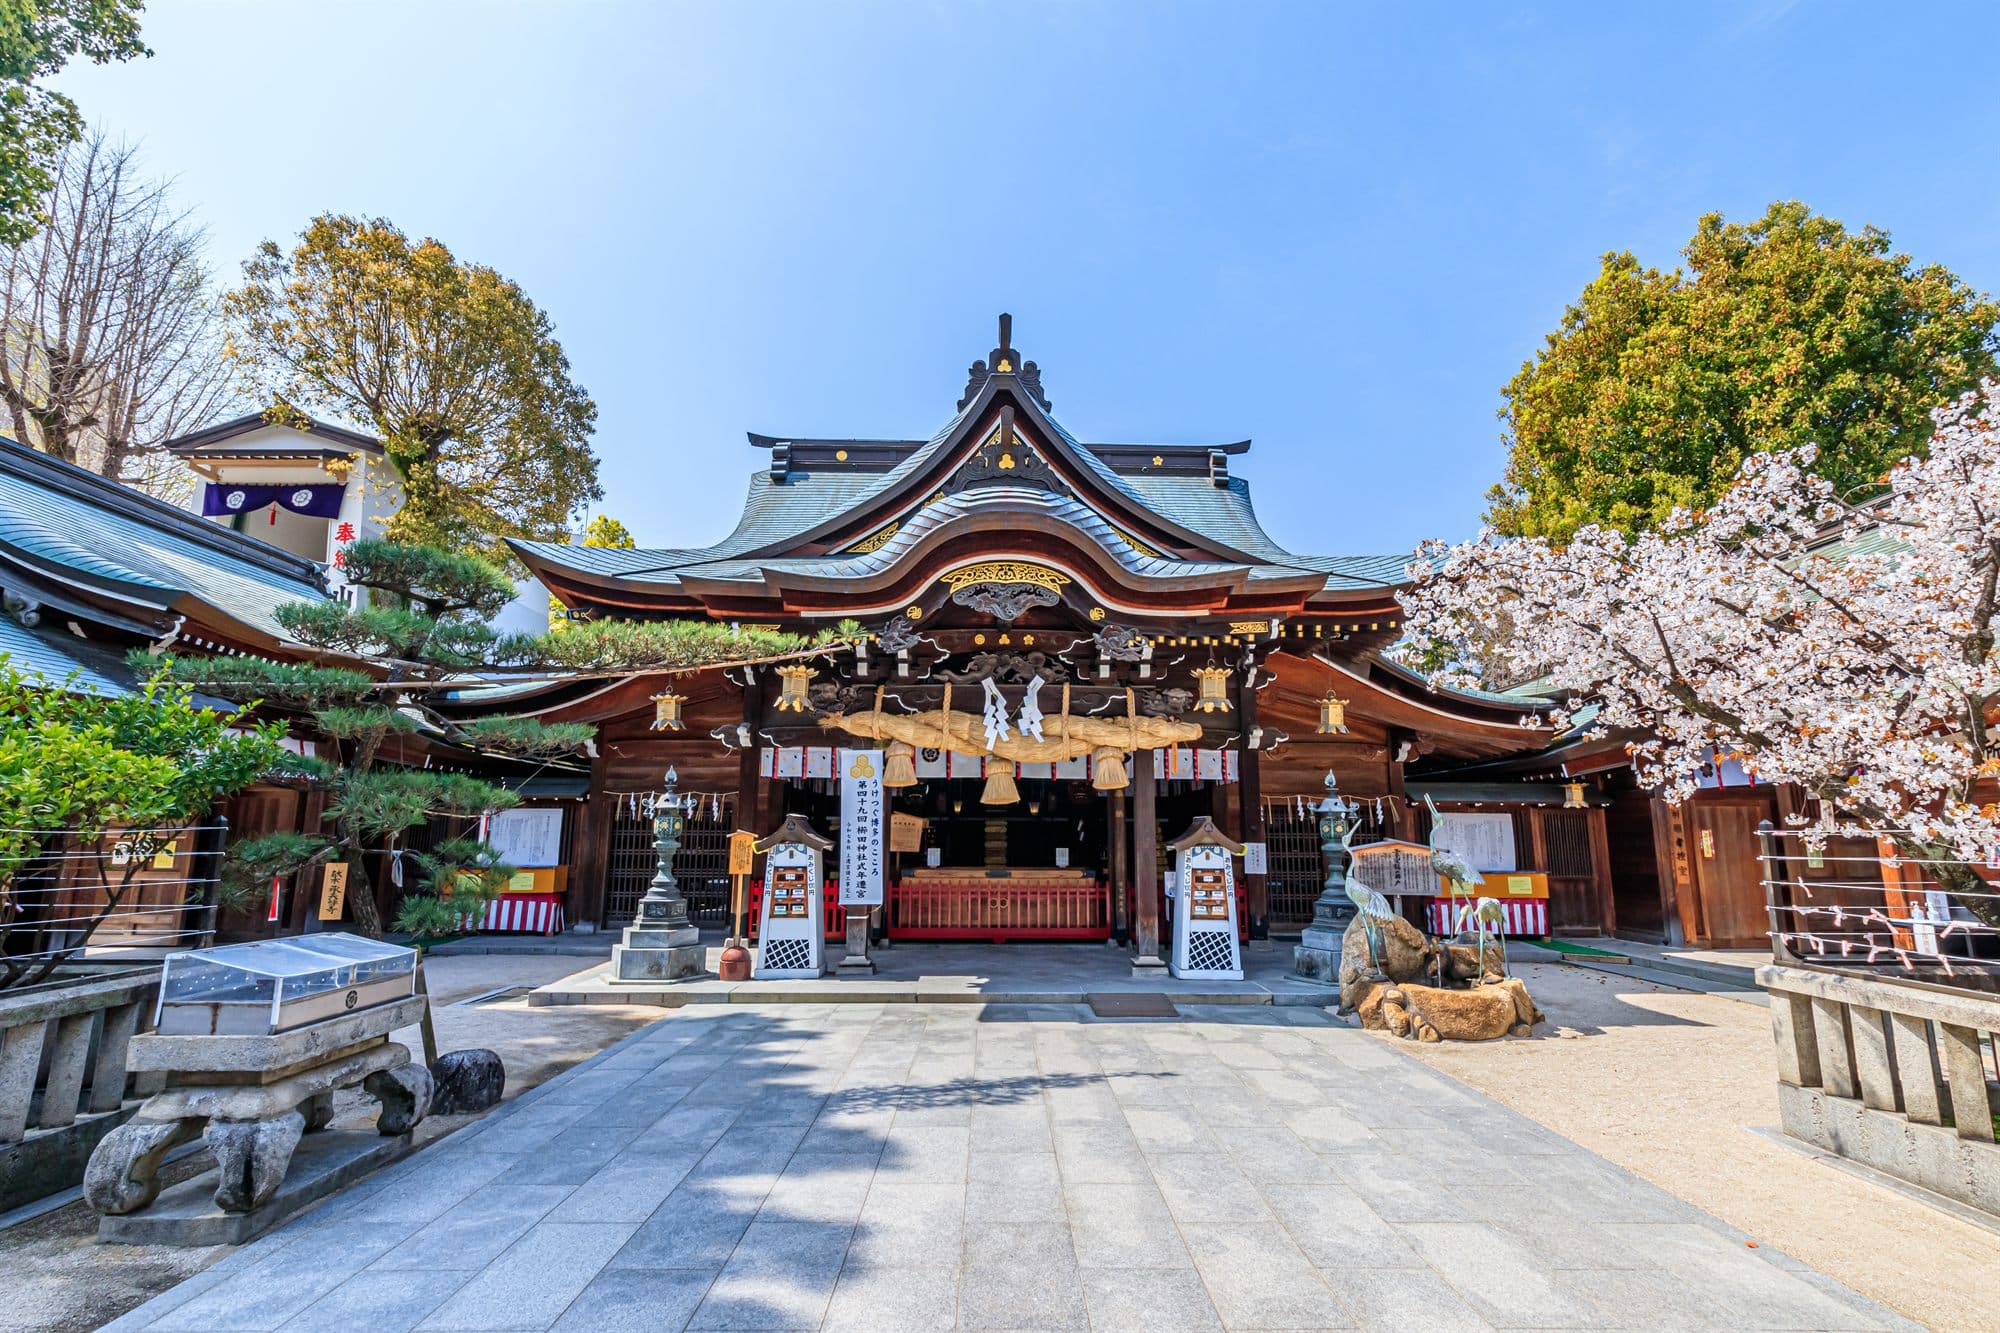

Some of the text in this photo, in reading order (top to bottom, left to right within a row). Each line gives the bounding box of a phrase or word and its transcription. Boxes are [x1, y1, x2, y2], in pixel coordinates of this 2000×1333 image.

[855, 780, 868, 899] 第四十九回 櫛田神社式年遷宮
[870, 779, 880, 877] うけつぐ博多のこころ
